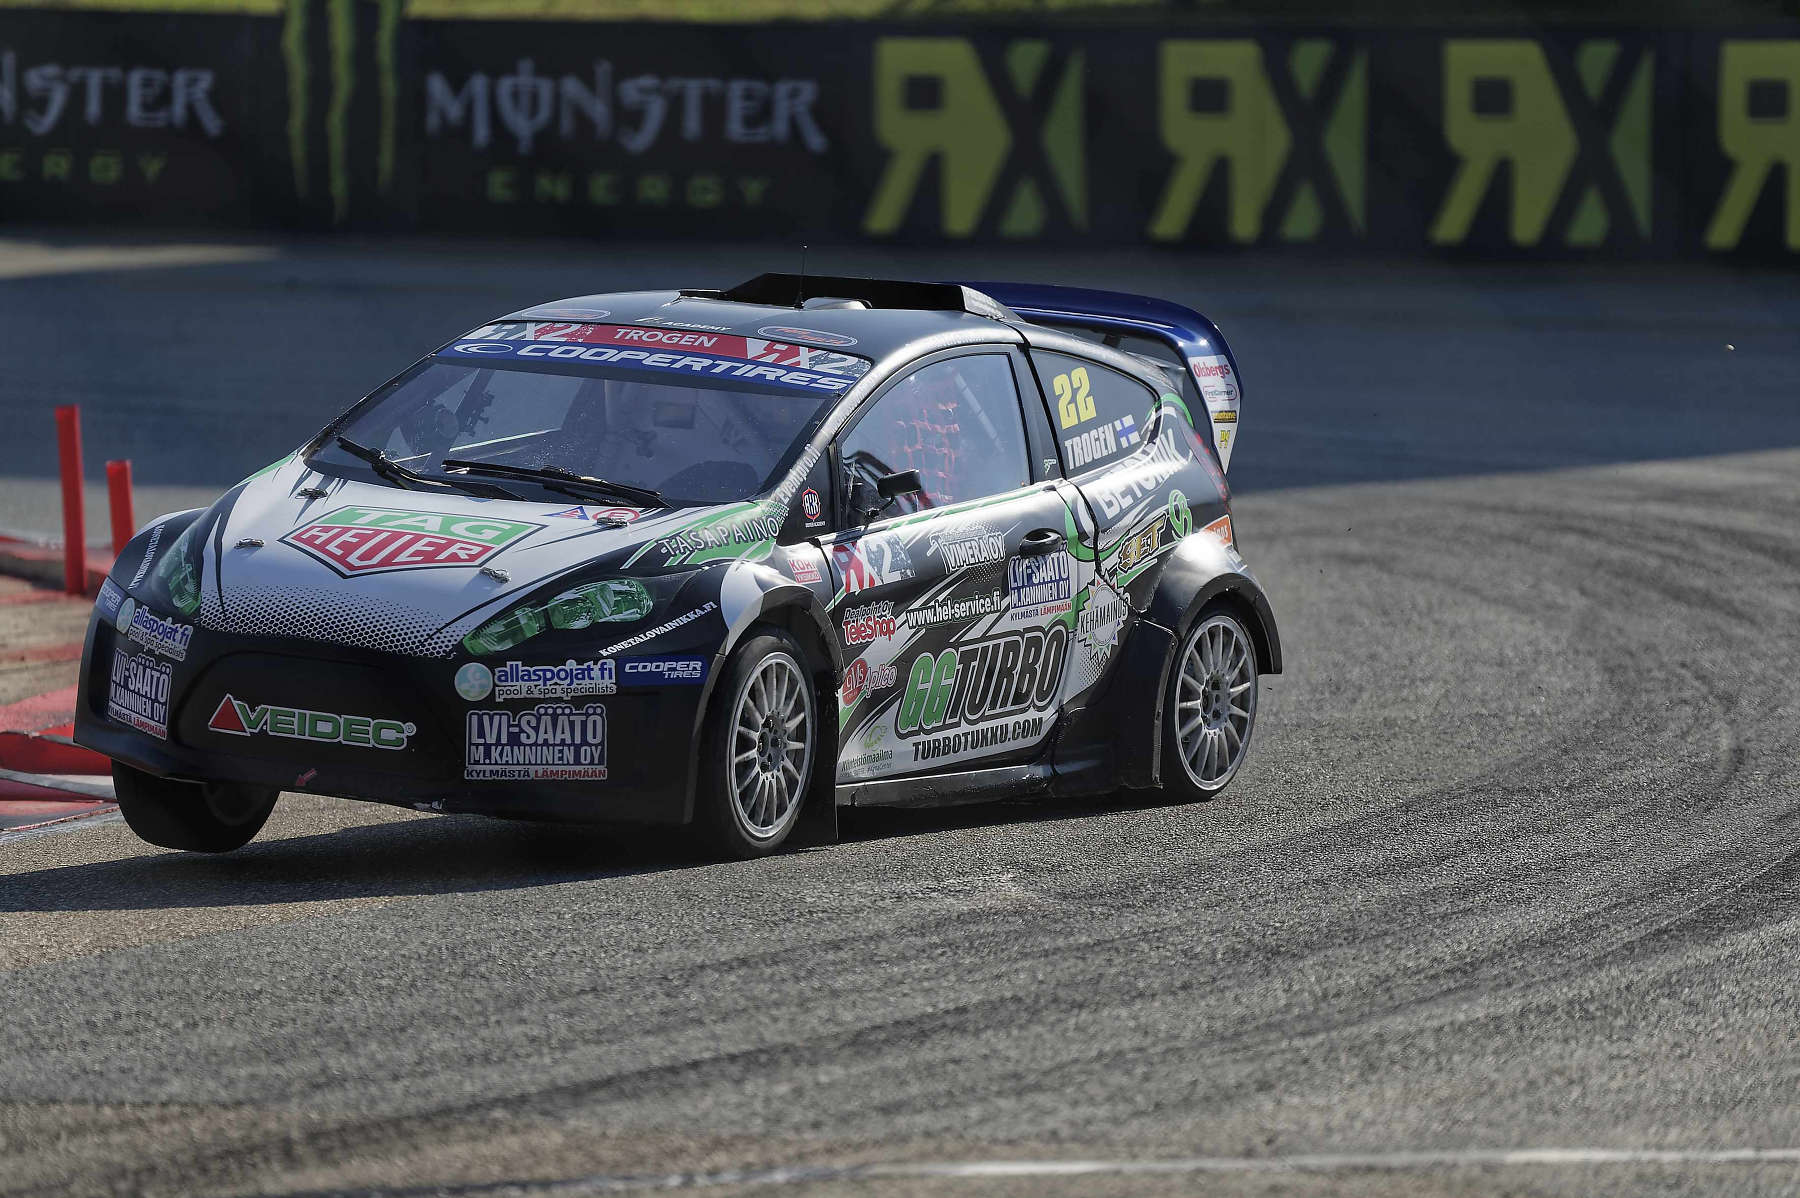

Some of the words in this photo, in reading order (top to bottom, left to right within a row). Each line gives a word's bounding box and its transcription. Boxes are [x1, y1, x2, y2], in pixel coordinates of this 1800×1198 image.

[0, 48, 225, 137] STER
[425, 57, 828, 154] MONSTER
[1704, 40, 1800, 250] R
[0, 152, 168, 183] ERGY
[487, 169, 771, 206] ENERGY
[613, 328, 719, 348] TROGEN
[1193, 361, 1231, 379] Olsbergs
[1053, 366, 1097, 430] 22
[1064, 423, 1117, 471] TROGEN
[351, 510, 513, 540] TAG
[661, 518, 780, 557] TASAPAINO
[301, 527, 483, 567] HEUER
[944, 537, 987, 568] VIMERA
[987, 534, 1005, 560] OY
[844, 601, 883, 620] Dealpoint
[882, 601, 894, 617] Oy
[906, 592, 1000, 628] www.hel-service.fi
[1011, 583, 1057, 608] M.KANNINEN
[1059, 581, 1070, 599] OY
[599, 601, 718, 657] KONETALOVAINIKKA.FI
[843, 616, 897, 644] TeleShop
[1011, 610, 1040, 621] KYLMÄSTÄ
[1080, 598, 1128, 635] KEHÄMAINOS
[625, 661, 702, 673] COOPER
[662, 671, 702, 679] TIRES
[862, 663, 898, 698] Aplico
[900, 629, 1064, 731] GGTURBO
[498, 685, 522, 698] pool
[526, 686, 534, 695] &
[538, 686, 557, 698] spa
[560, 684, 614, 697] specialists
[153, 702, 167, 723] OY
[235, 701, 405, 748] VEIDEC
[471, 706, 603, 744] LVI-SÄÄTÖ
[470, 745, 574, 765] M.KANNINEN
[580, 745, 602, 765] OY
[913, 717, 1043, 762] TURBOTUKKU.COM
[466, 767, 530, 779] KYLMÄSTÄ
[534, 766, 607, 779] LÄMPIMÄÄN
